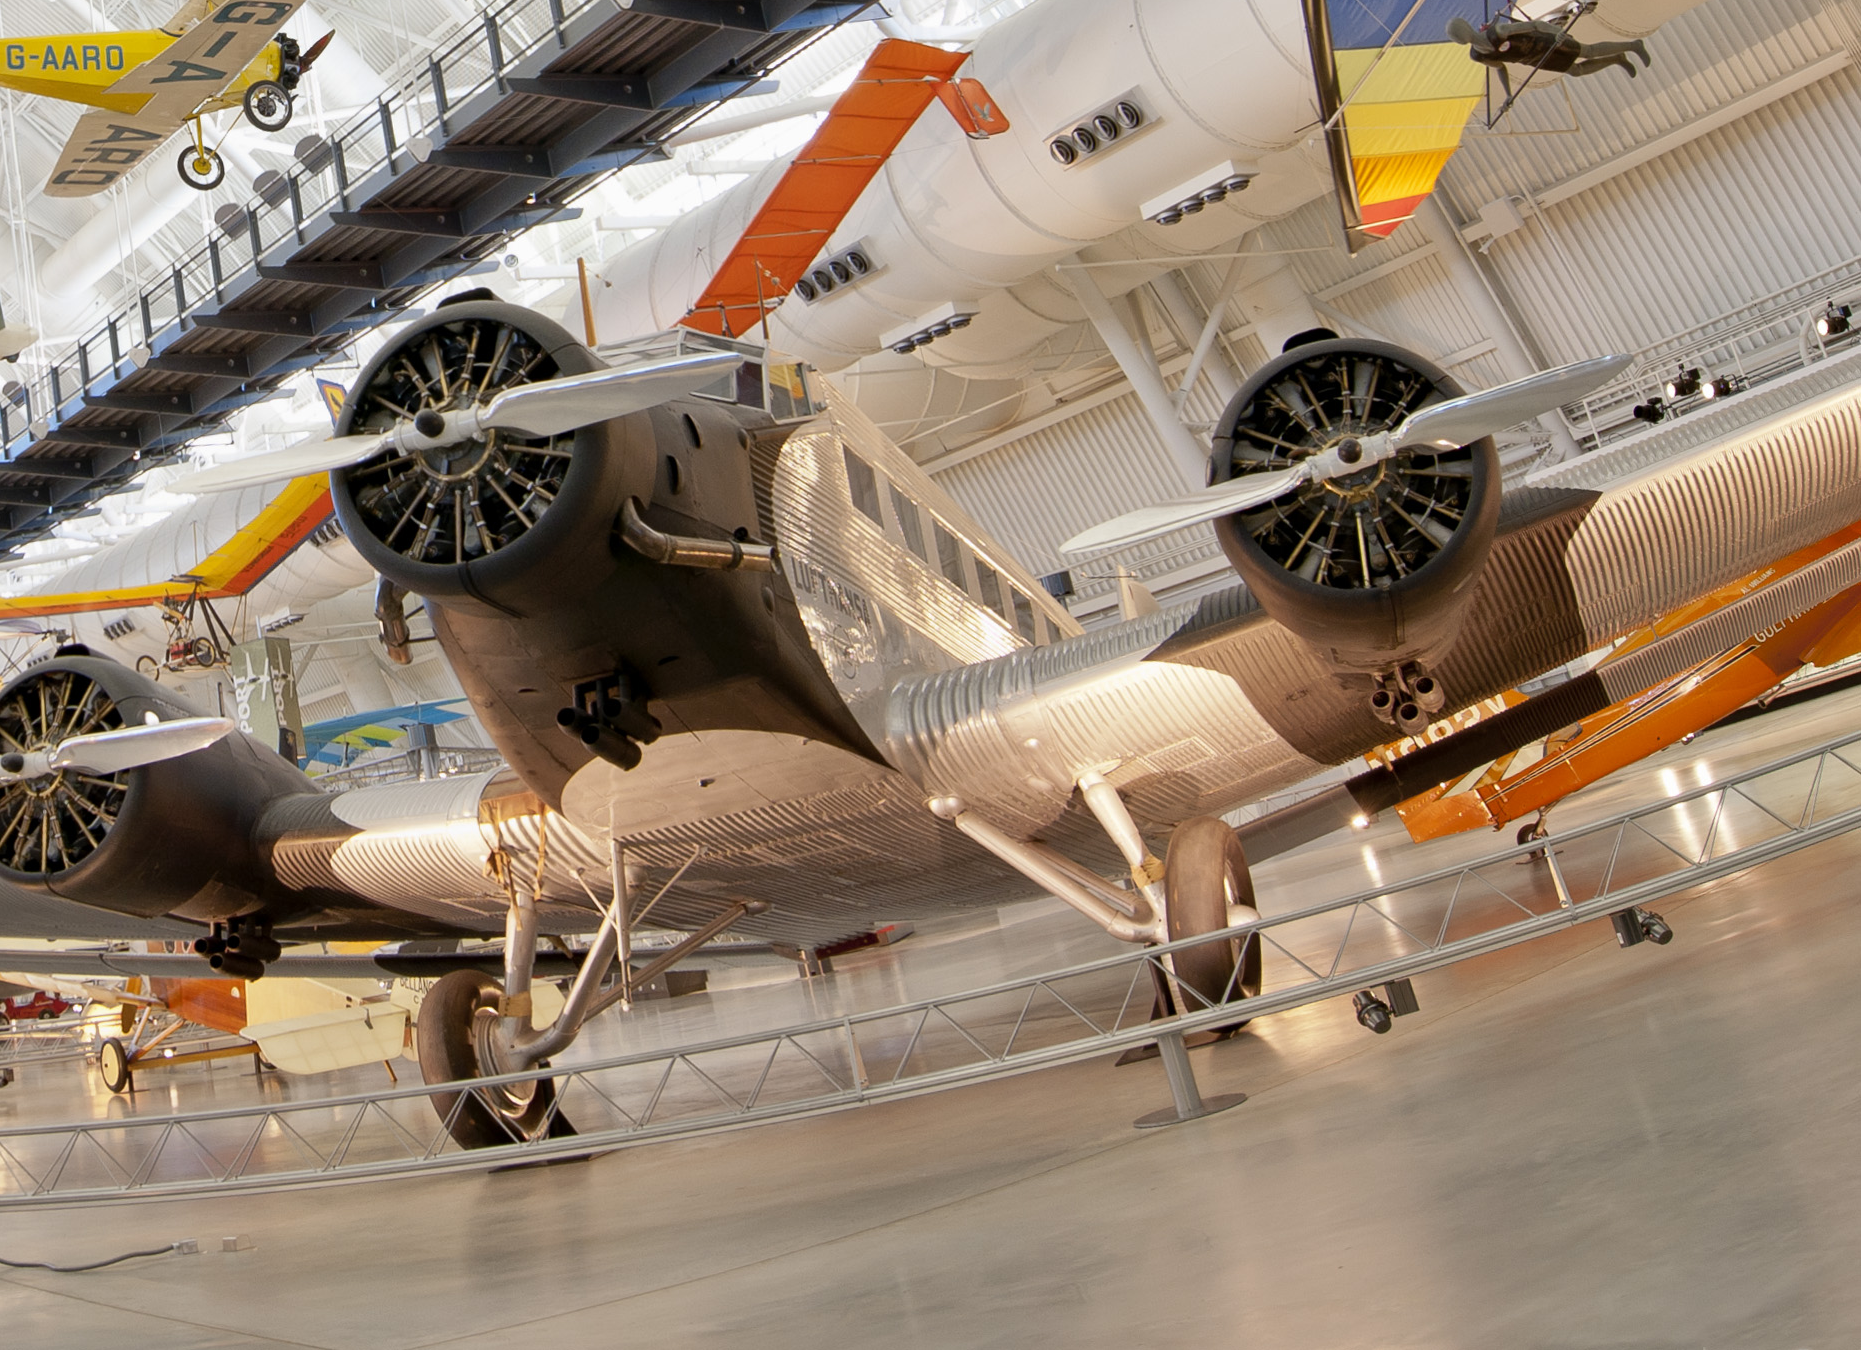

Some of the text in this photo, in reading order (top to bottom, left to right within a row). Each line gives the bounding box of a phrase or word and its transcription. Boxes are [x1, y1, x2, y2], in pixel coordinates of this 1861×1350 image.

[5, 44, 125, 71] G-AARO
[1749, 568, 1777, 590] WILLIAMS
[233, 674, 257, 735] PORT
[270, 664, 288, 727] PORT
